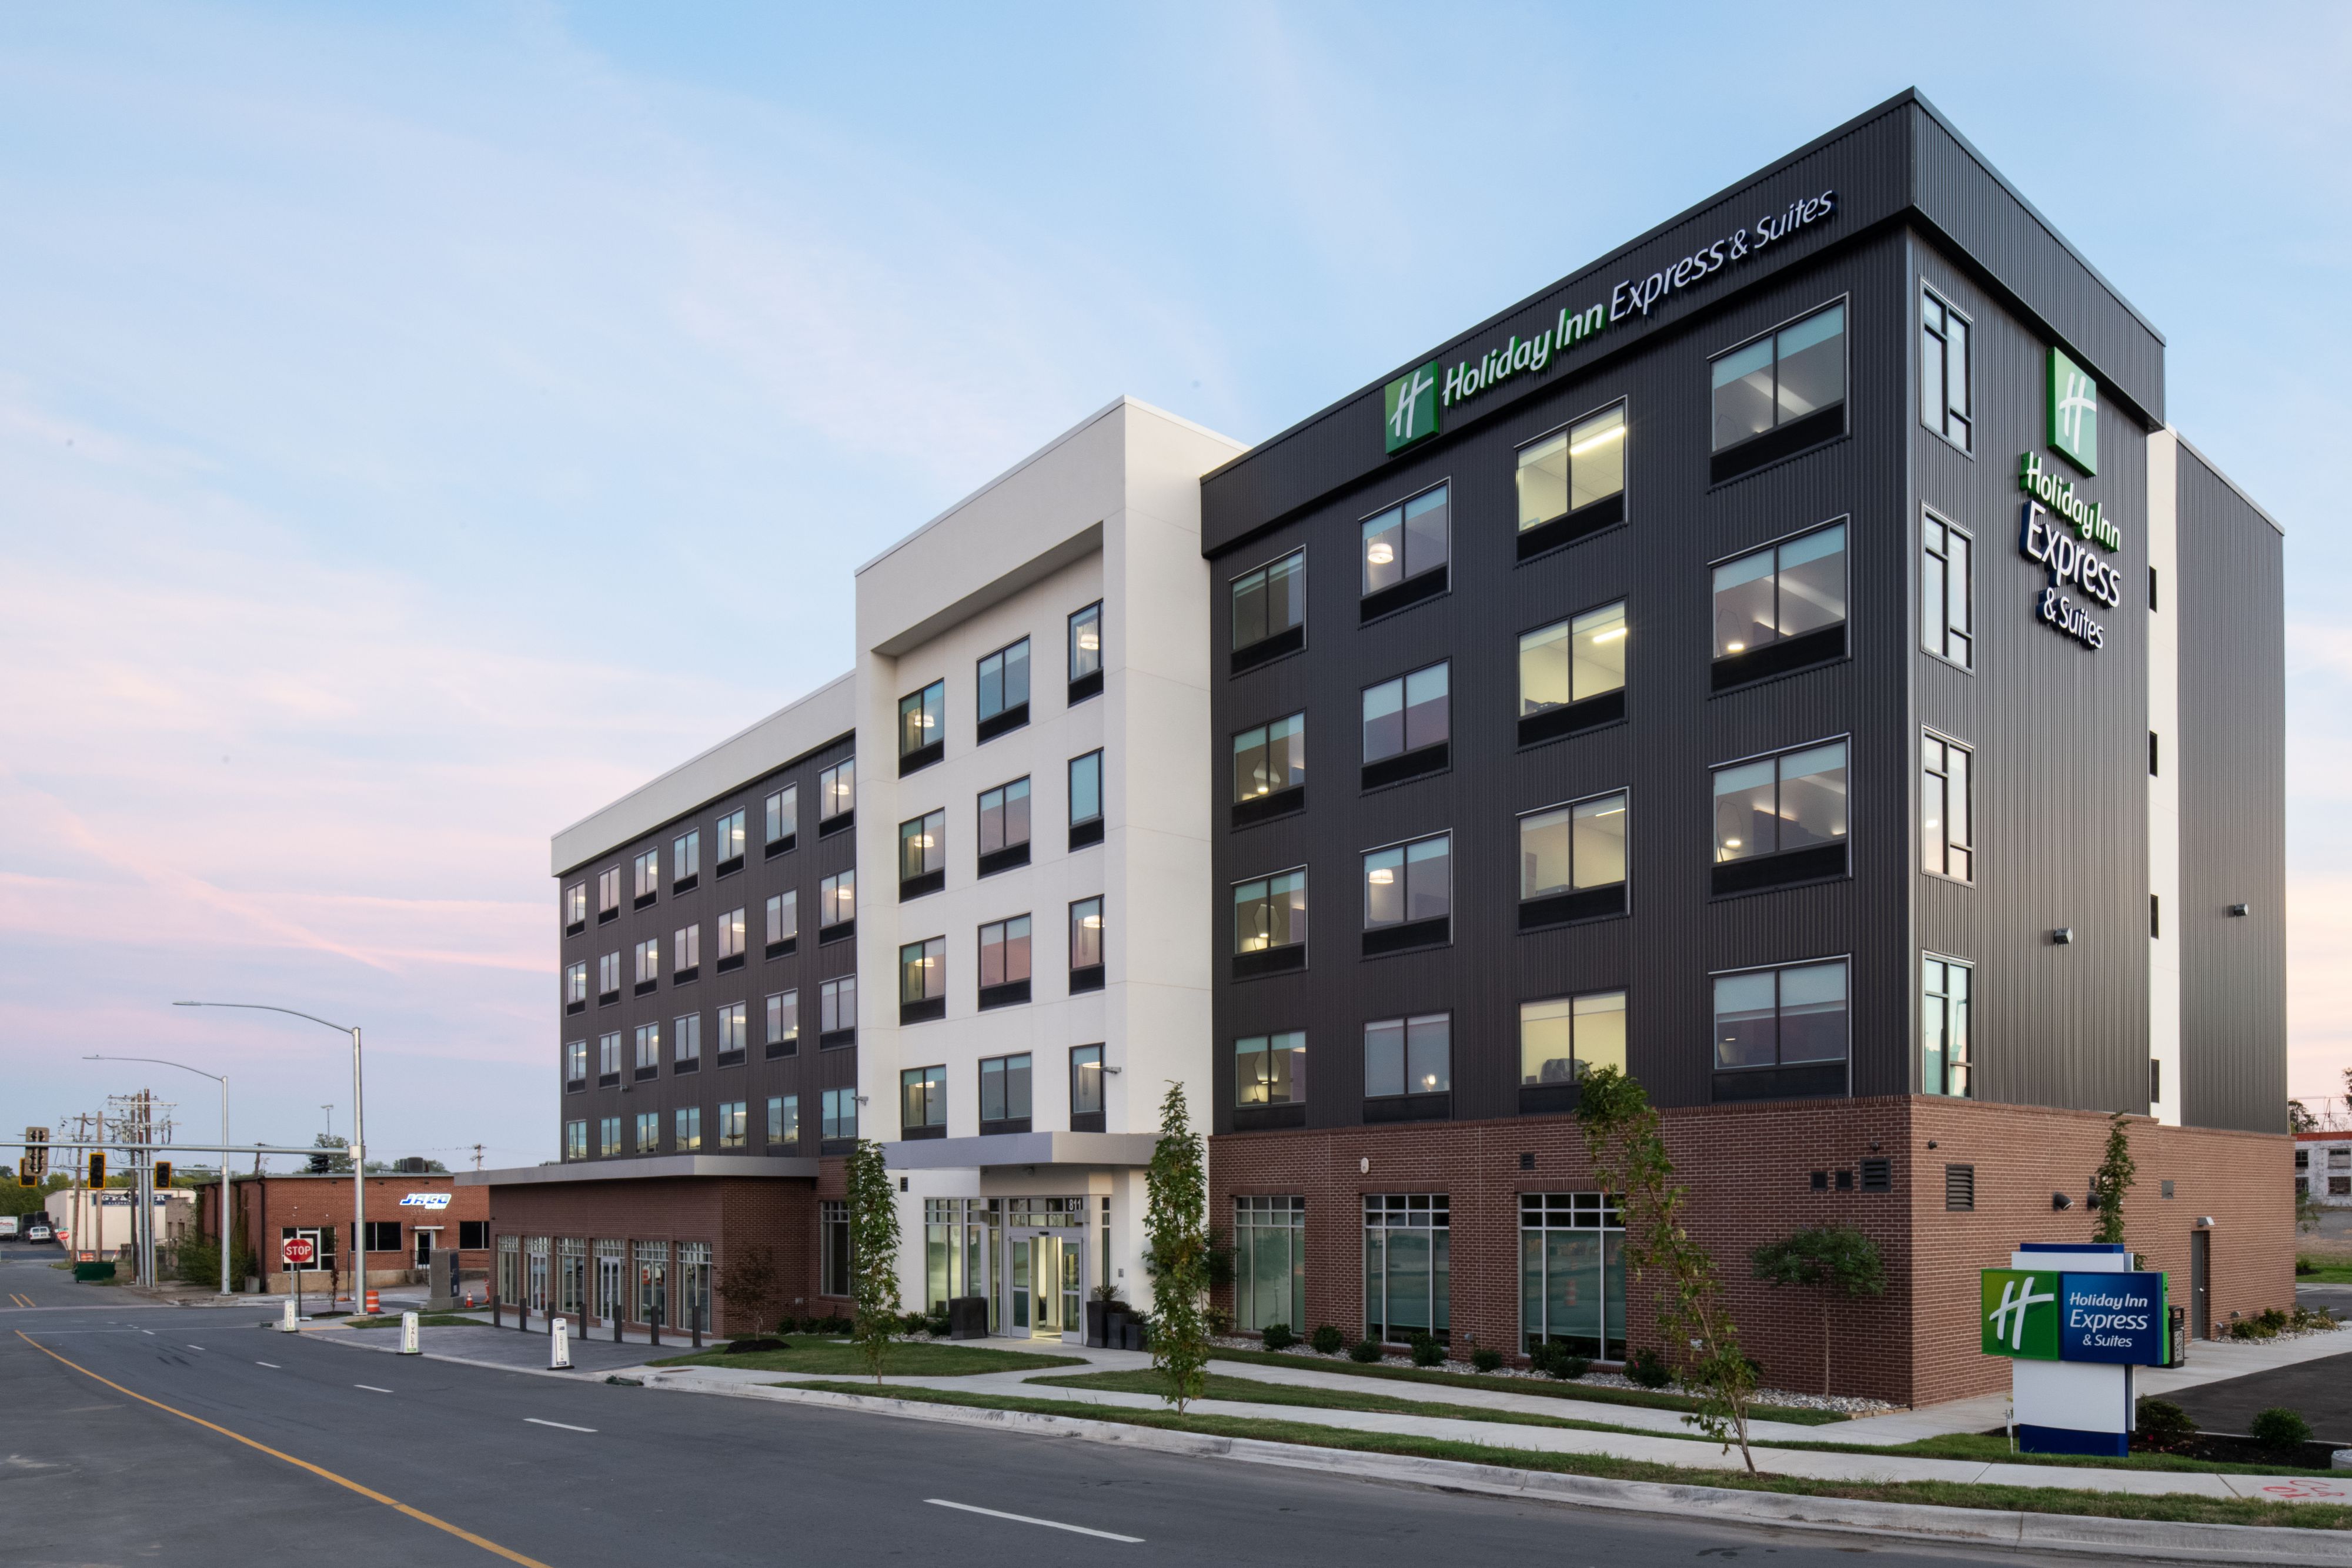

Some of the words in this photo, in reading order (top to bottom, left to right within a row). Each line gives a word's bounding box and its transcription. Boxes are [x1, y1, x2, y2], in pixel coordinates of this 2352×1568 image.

[1442, 329, 1552, 406] Holiday
[1555, 303, 1603, 349] Inn
[1610, 239, 1725, 322] Express
[1730, 229, 1748, 260] &
[1755, 190, 1833, 249] Suites
[2026, 450, 2094, 540] Holiday
[2096, 502, 2120, 552] Inn
[2027, 500, 2121, 607] Express
[2044, 587, 2056, 623] &
[2059, 596, 2104, 648] Suites
[400, 1194, 451, 1205] JACO
[1069, 1199, 1081, 1211] 811
[286, 1246, 311, 1256] STOP
[2069, 1292, 2123, 1310] Holiday
[2124, 1293, 2148, 1308] Inn
[2070, 1309, 2148, 1333] Express
[2082, 1333, 2092, 1346] &
[2094, 1334, 2133, 1348] Suites
